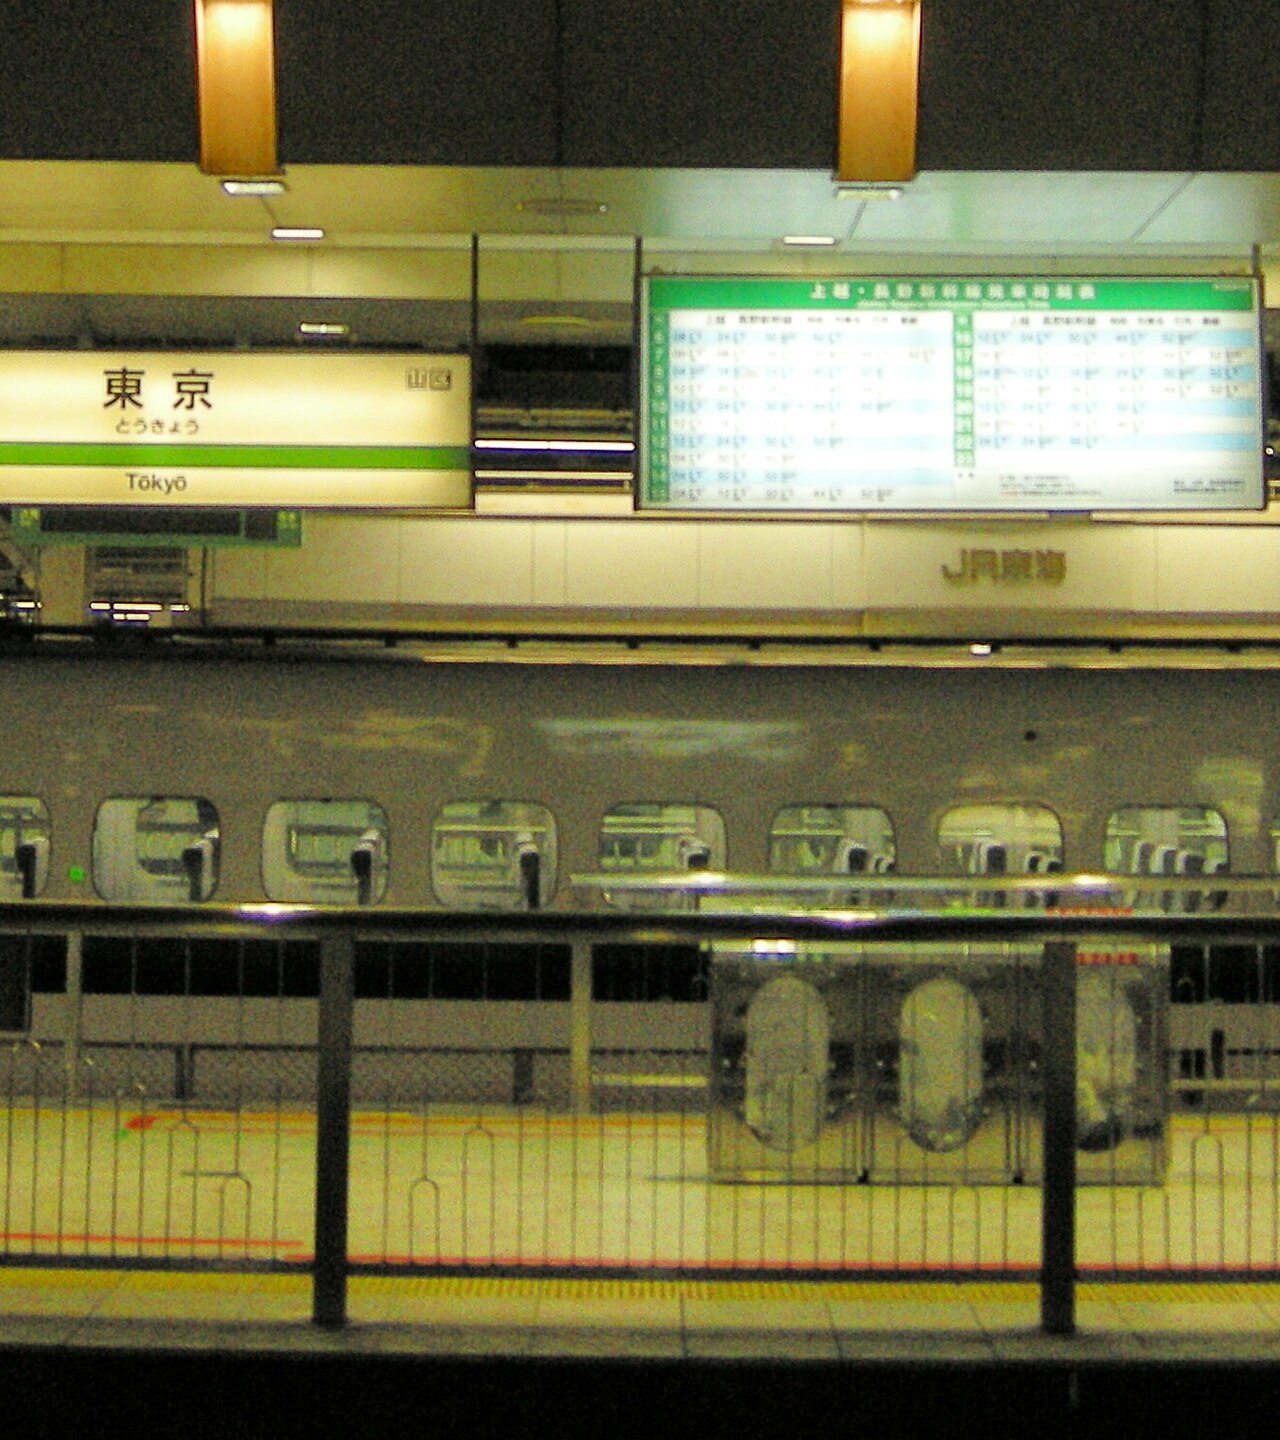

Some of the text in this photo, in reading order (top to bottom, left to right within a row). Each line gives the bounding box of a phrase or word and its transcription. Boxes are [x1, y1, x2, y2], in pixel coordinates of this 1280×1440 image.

[103, 366, 214, 409] 東京
[115, 418, 199, 435] とうきょう
[125, 472, 188, 495] Tōkyō
